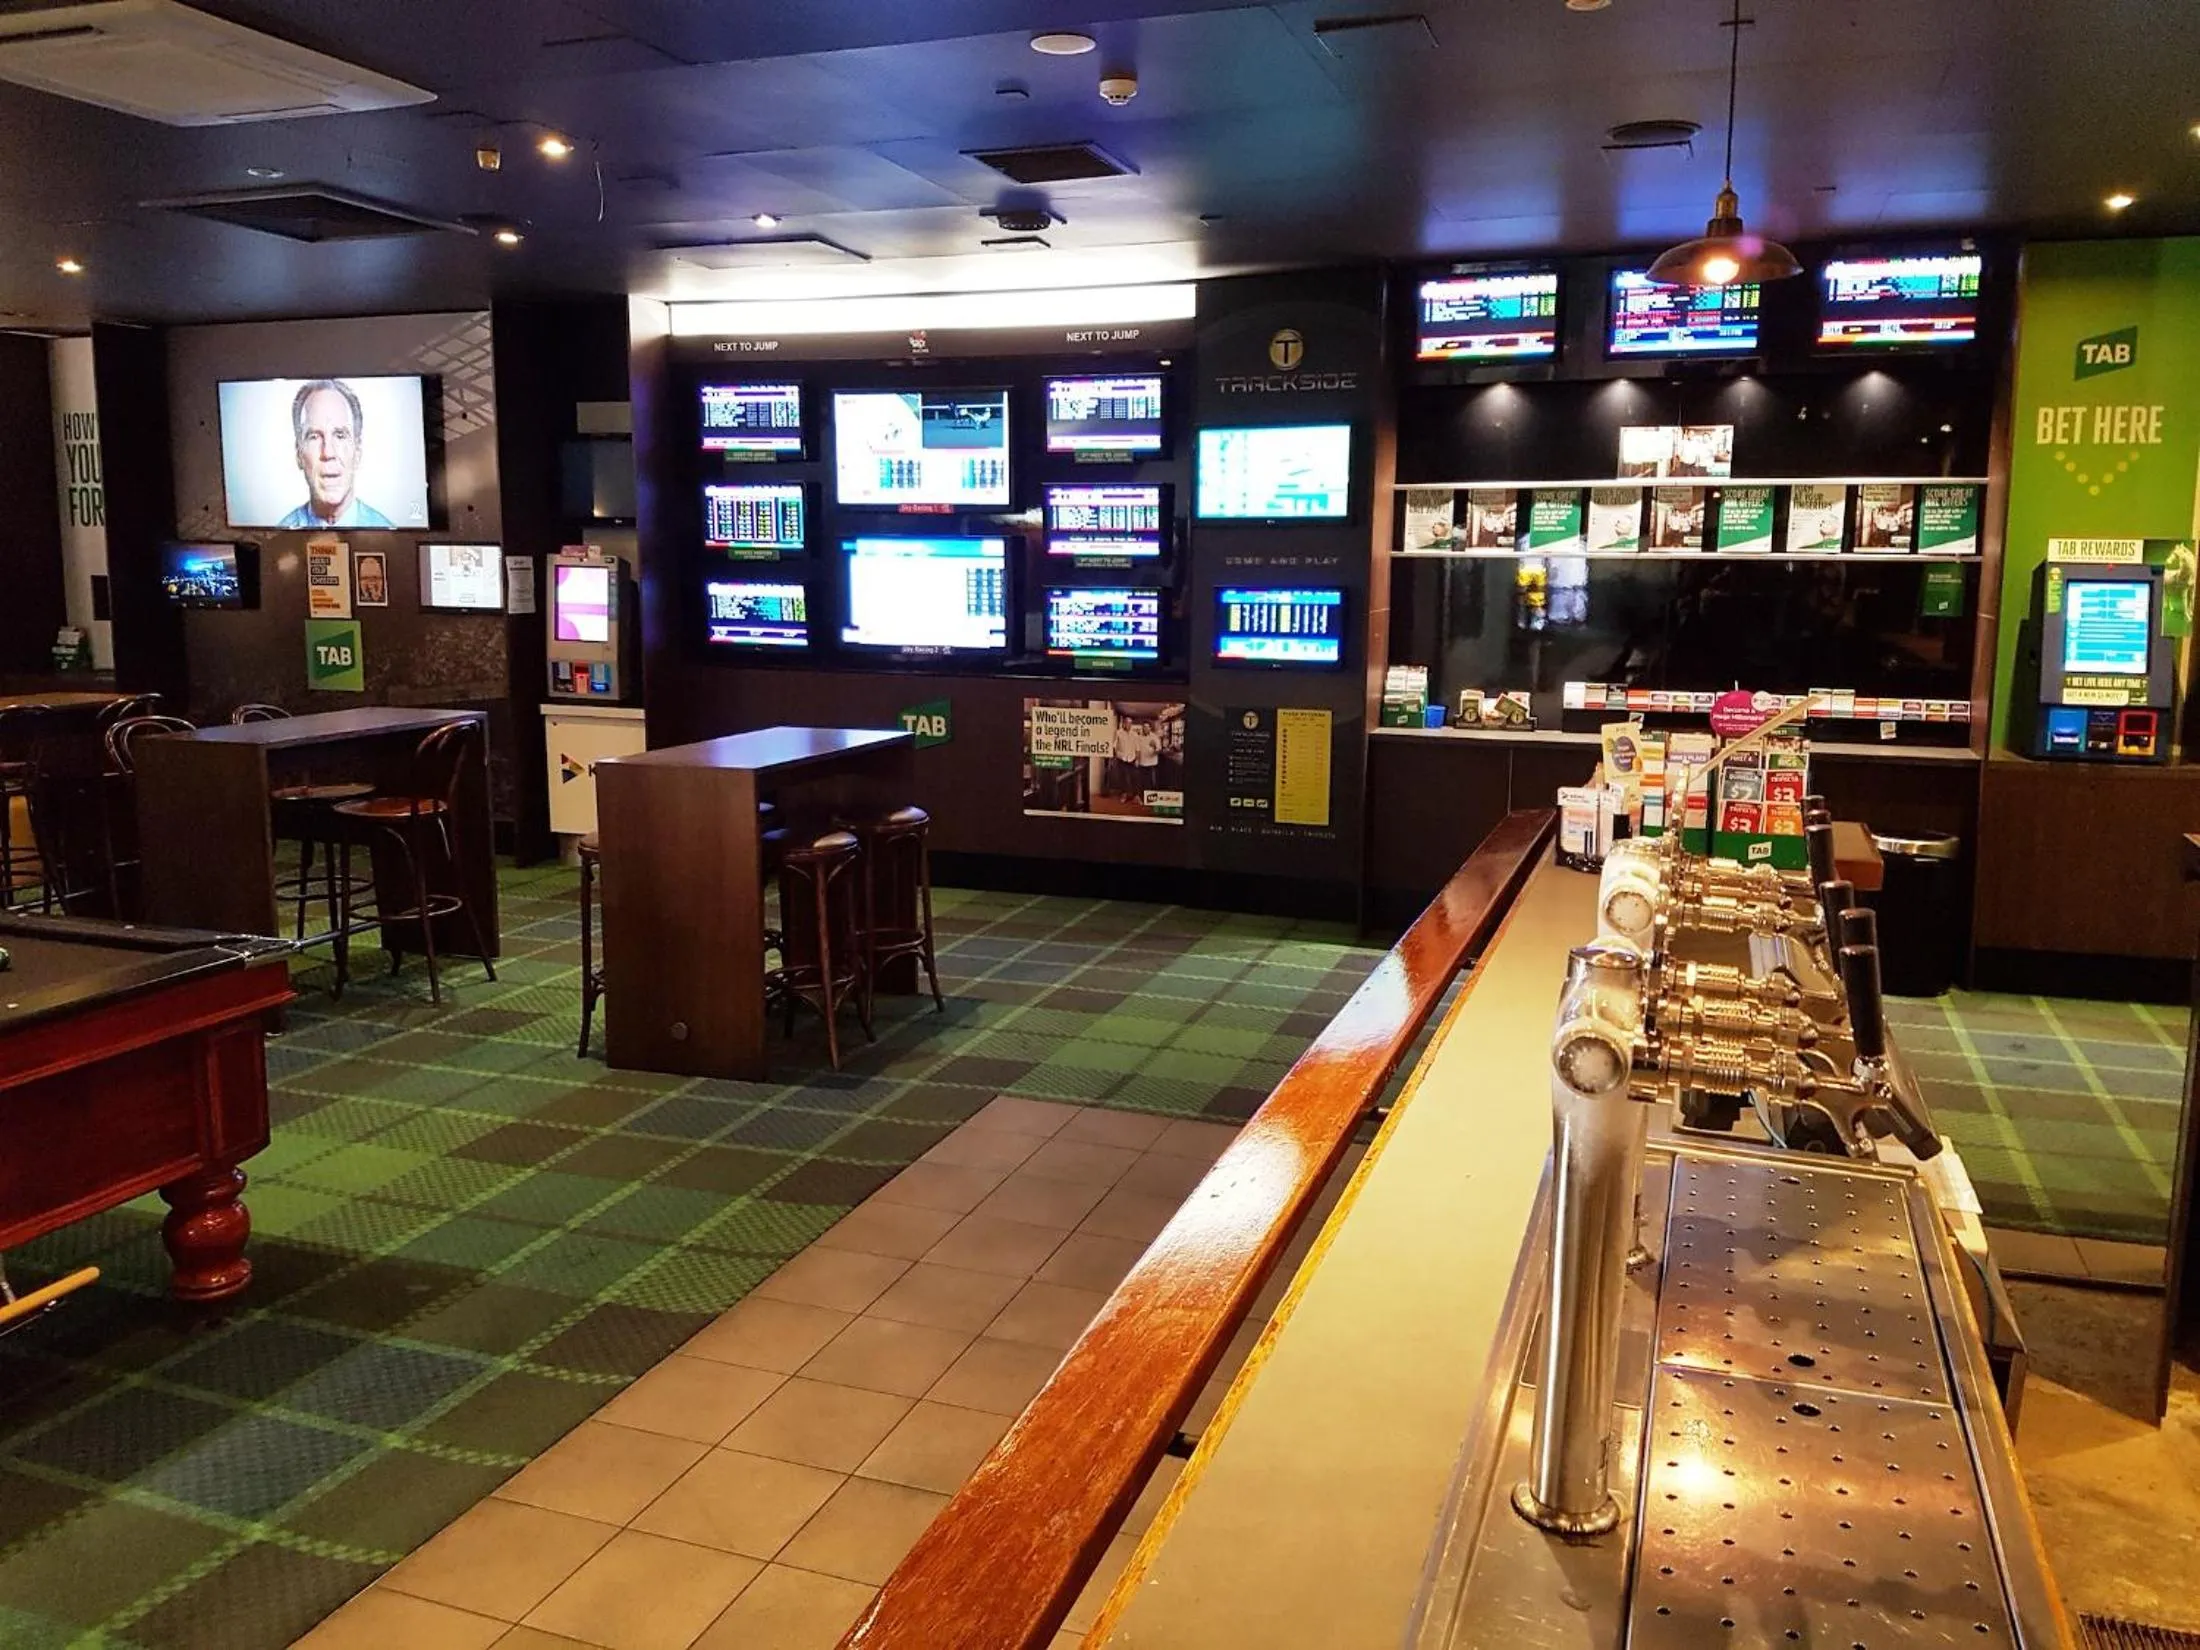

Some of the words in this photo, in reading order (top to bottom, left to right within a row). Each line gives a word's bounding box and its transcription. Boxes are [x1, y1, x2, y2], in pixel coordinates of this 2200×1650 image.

[1067, 331, 1093, 341] NEXT
[1095, 331, 1110, 340] TO
[1112, 330, 1140, 340] JUMP
[714, 342, 738, 352] NEXT
[740, 342, 752, 351] TO
[754, 341, 778, 351] JUMP
[2081, 343, 2131, 364] TAB
[1215, 372, 1358, 393] TRACKSIDE
[63, 412, 95, 440] HOW
[2037, 406, 2087, 445] BET
[2093, 405, 2164, 444] HERE
[66, 443, 101, 483] YOU
[70, 487, 104, 527] FOR
[2057, 540, 2077, 556] TAB
[2081, 541, 2135, 557] REWARDS
[1270, 557, 1296, 565] AND
[1305, 557, 1339, 565] PLAY
[316, 646, 352, 666] TAB
[902, 715, 946, 737] TAB
[1035, 710, 1066, 724] Who'll
[1069, 713, 1108, 726] become
[1044, 725, 1078, 738] legend
[1081, 726, 1090, 737] in
[1036, 738, 1050, 750] the
[1054, 741, 1073, 752] NRL
[1076, 741, 1109, 754] Finals?
[1751, 846, 1769, 855] TAB
